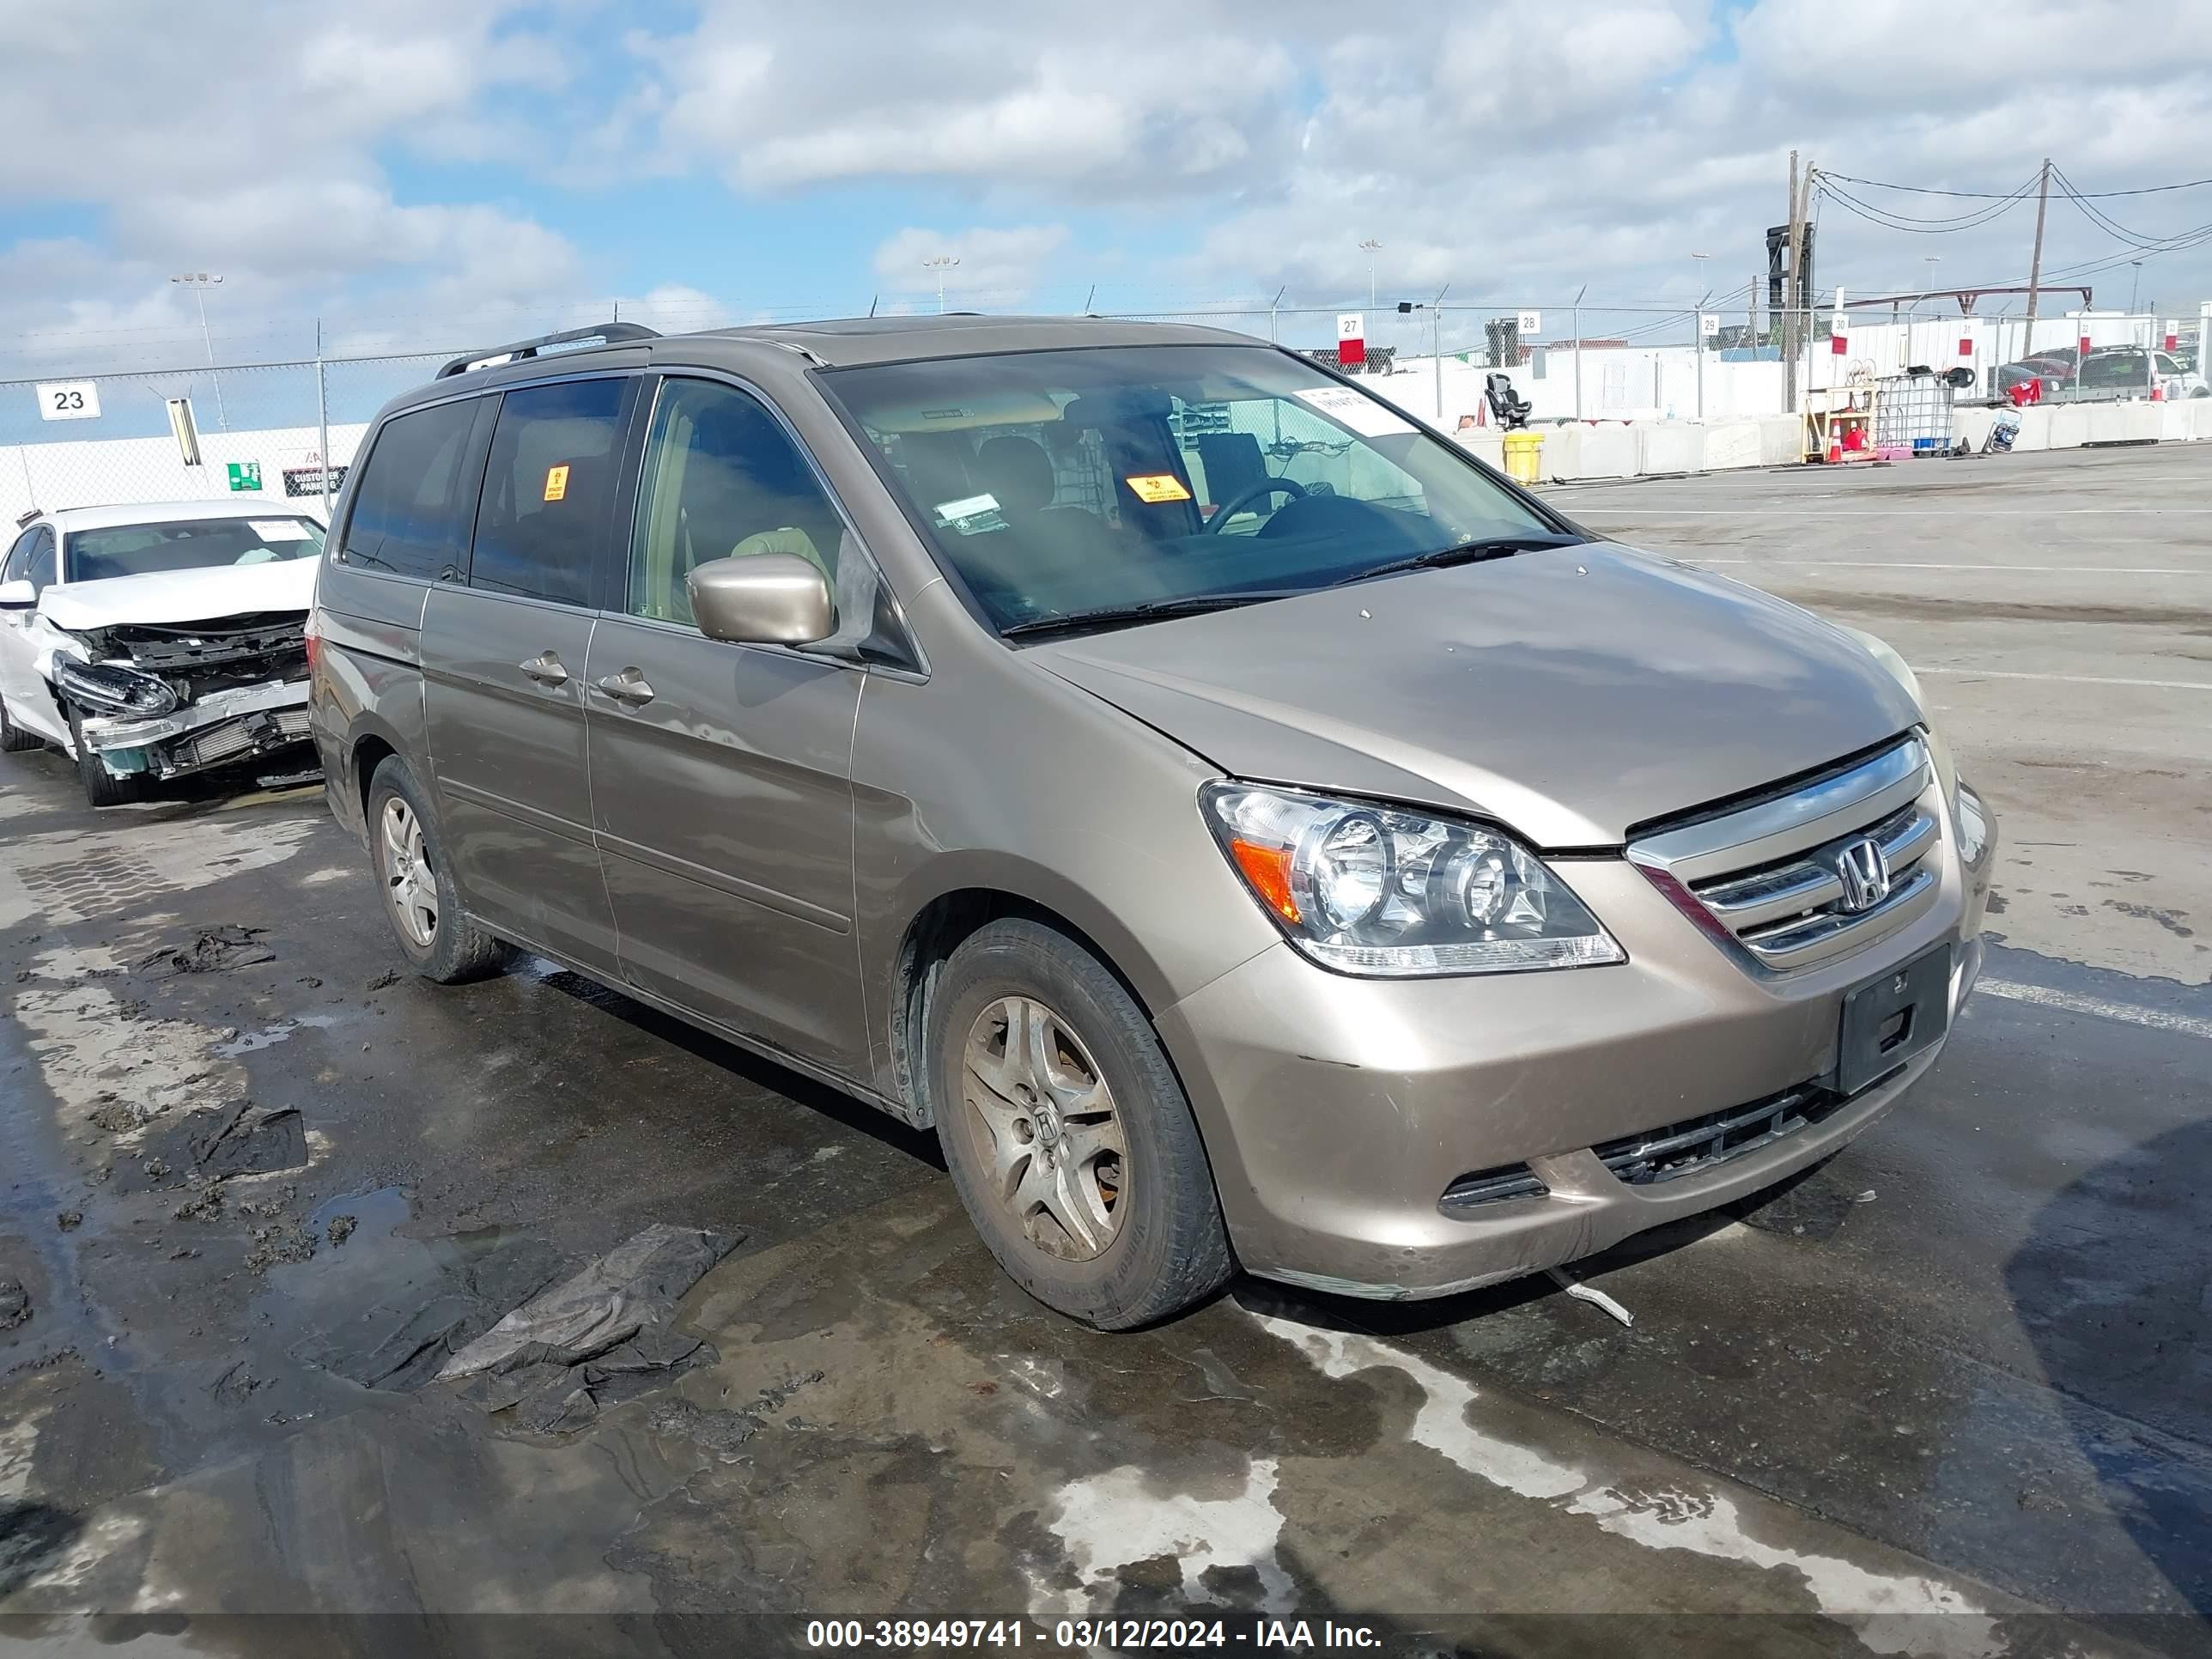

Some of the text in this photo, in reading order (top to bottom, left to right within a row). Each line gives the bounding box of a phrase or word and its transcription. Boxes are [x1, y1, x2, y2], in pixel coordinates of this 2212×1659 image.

[1344, 320, 1357, 332] 27
[1523, 317, 1535, 328] 28
[1705, 319, 1715, 331] 29
[1836, 319, 1845, 330] 30
[54, 392, 84, 410] 23
[295, 471, 339, 483] CUSTOER
[300, 480, 337, 491] PARKG
